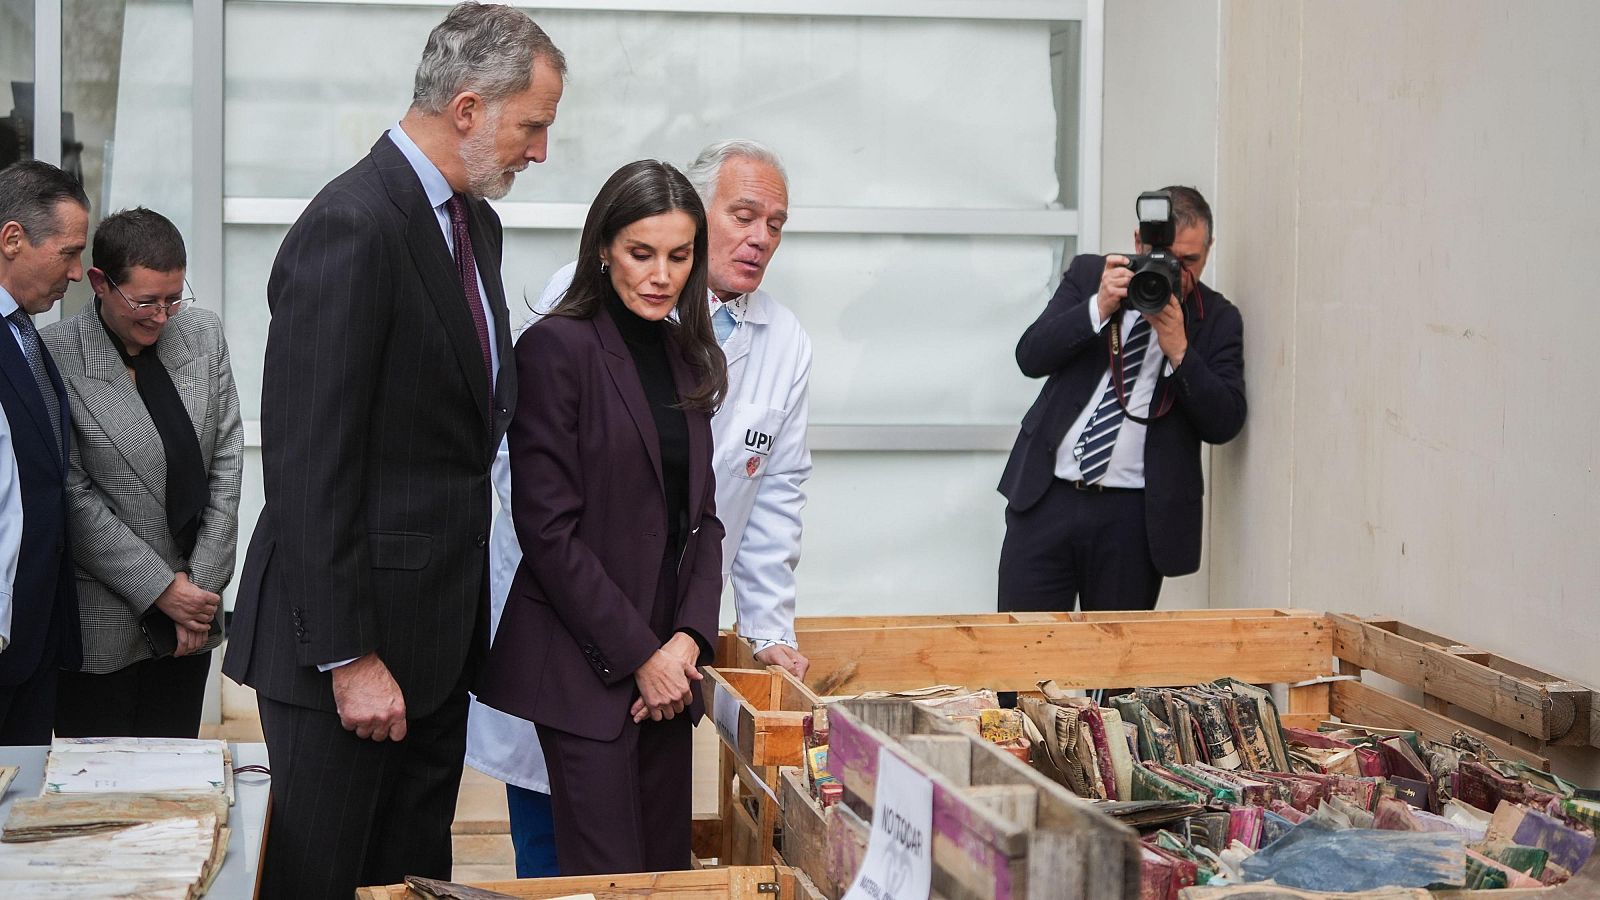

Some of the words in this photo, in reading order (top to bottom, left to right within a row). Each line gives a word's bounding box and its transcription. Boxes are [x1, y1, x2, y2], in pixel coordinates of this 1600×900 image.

[744, 428, 776, 451] UPV
[881, 804, 894, 834] NO
[895, 814, 923, 857] TOCAR
